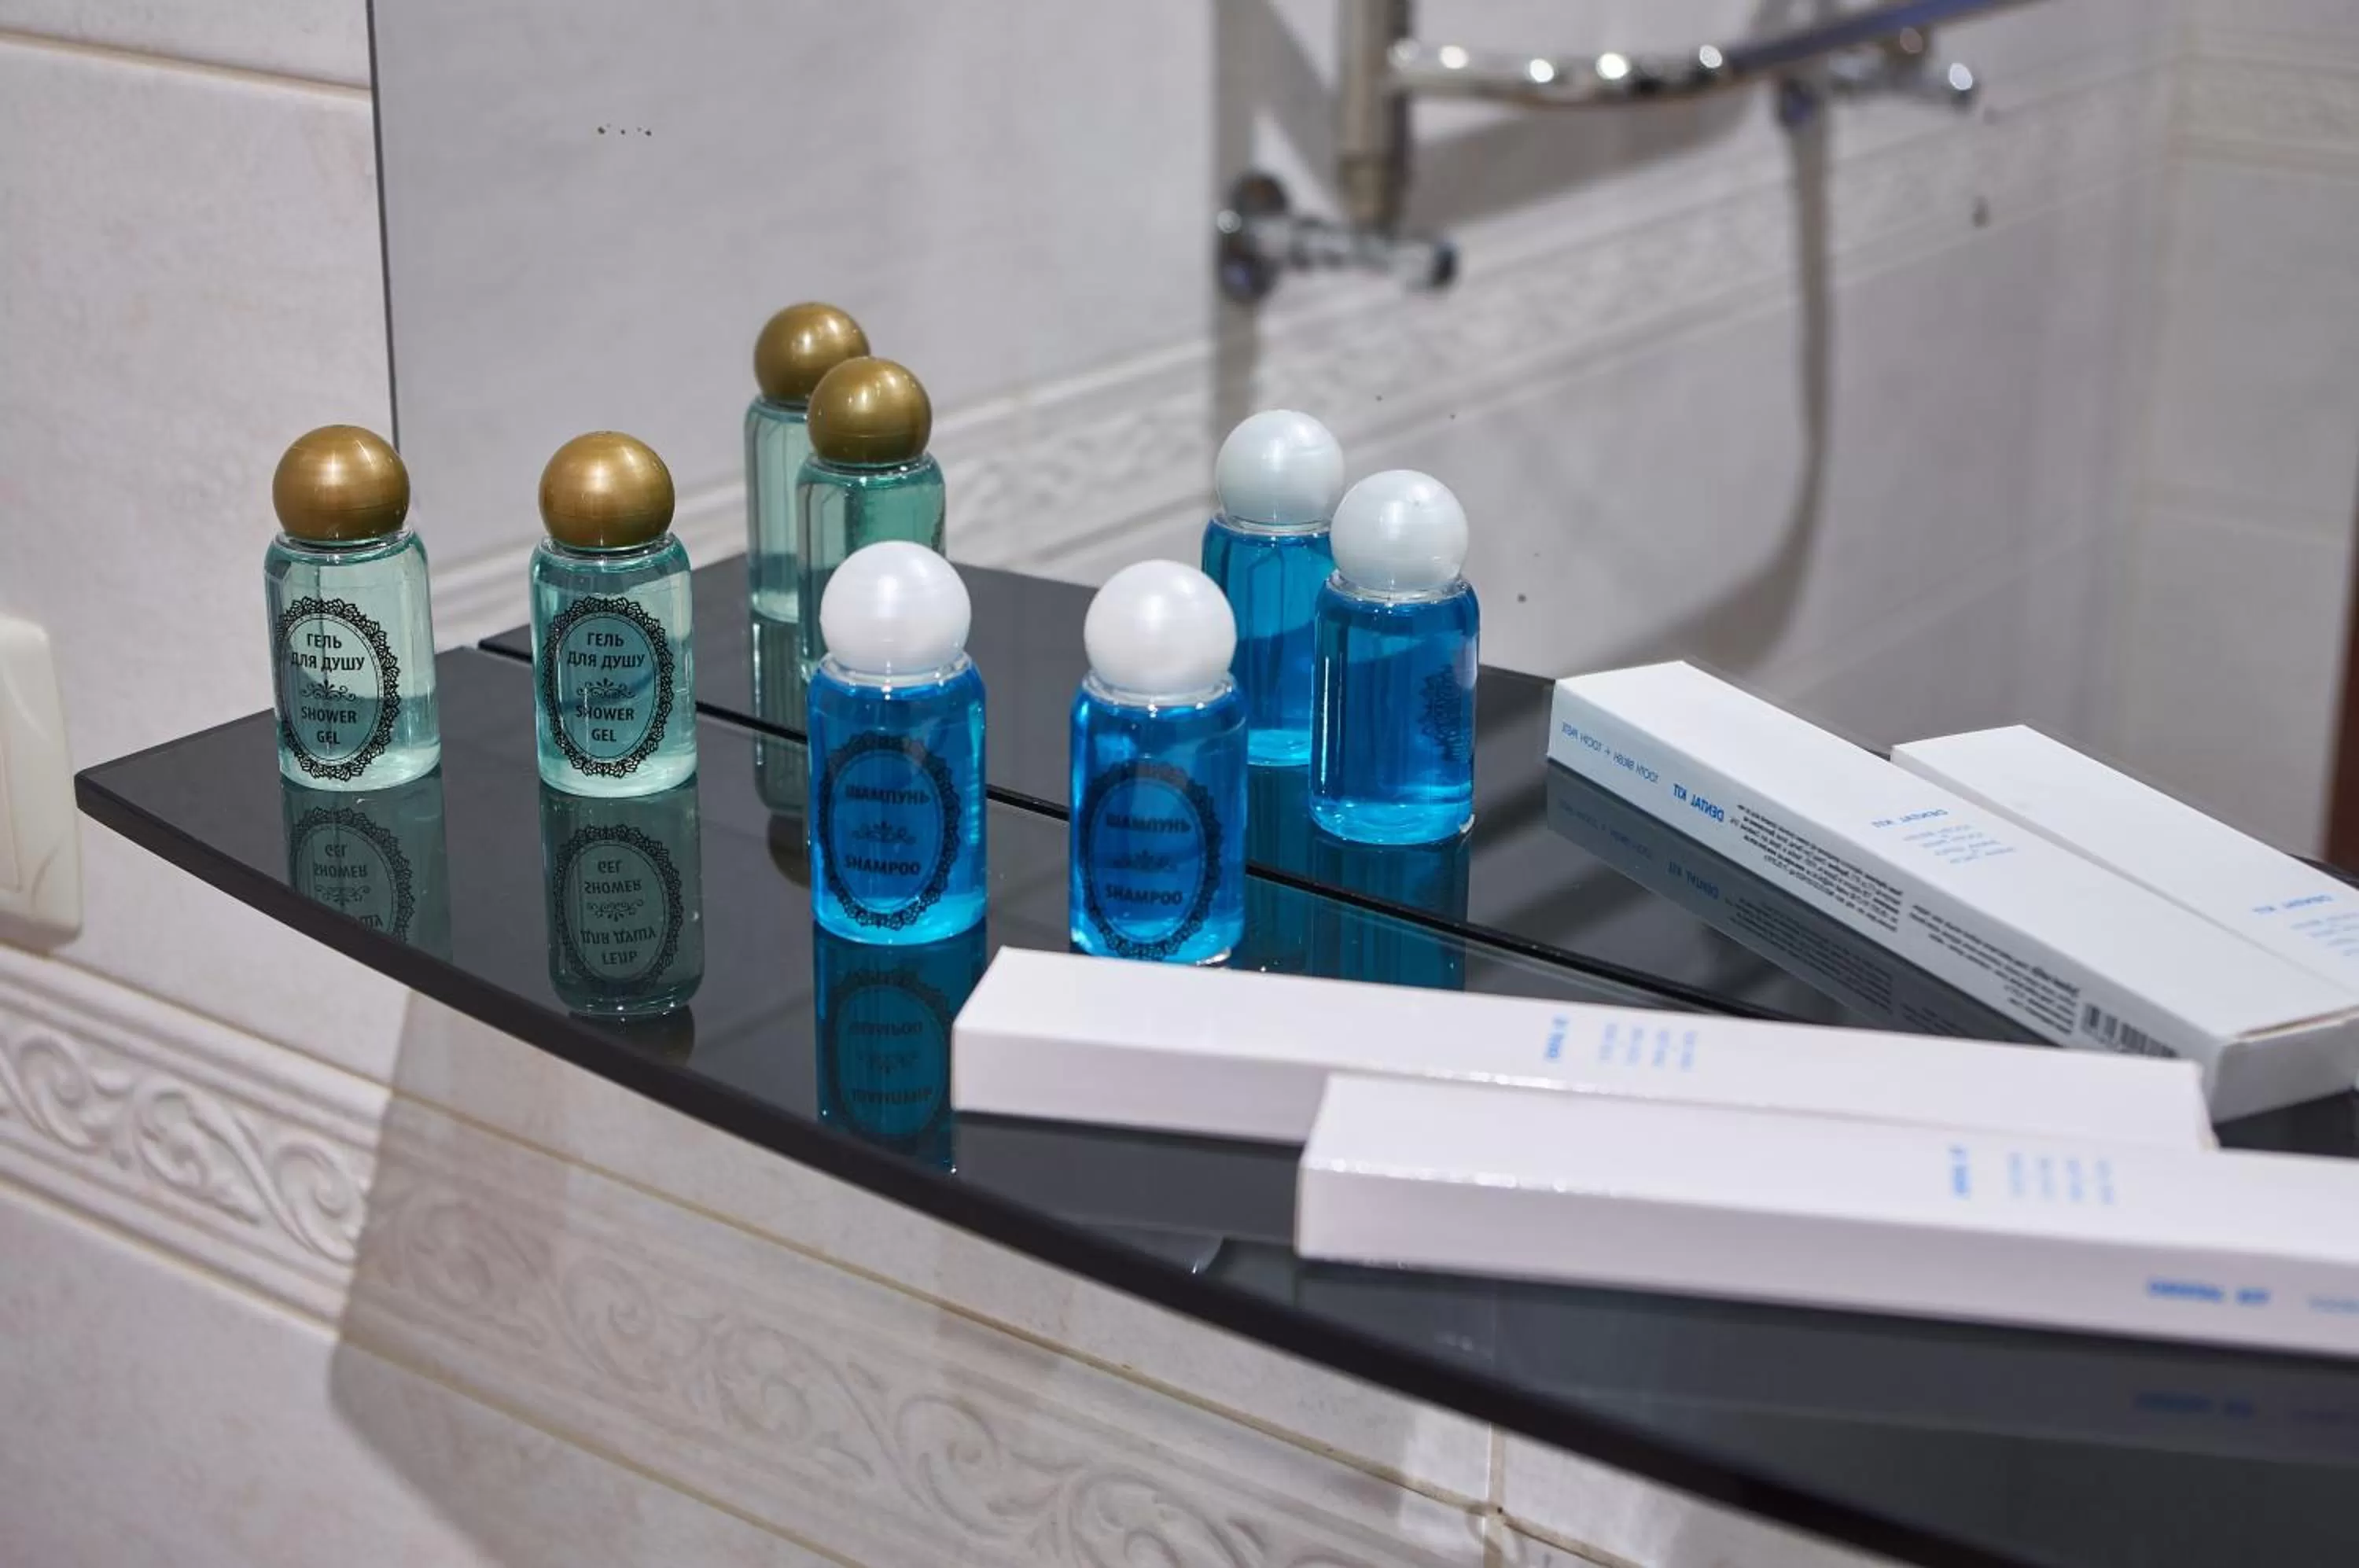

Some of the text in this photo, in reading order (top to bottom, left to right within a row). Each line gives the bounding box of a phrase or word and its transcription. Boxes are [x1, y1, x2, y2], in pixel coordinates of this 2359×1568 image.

[307, 633, 342, 649] ГЕЛЬ
[587, 632, 624, 647] ГЕЛЬ
[290, 652, 365, 672] ДЛЯ ДУШУ
[567, 651, 646, 671] ДЛЯ ДУШУ
[301, 706, 357, 723] SHOWER
[576, 705, 635, 721] SHOWER
[317, 731, 340, 744] GEL
[591, 728, 617, 742] GEL
[845, 785, 930, 805] ШАМПУНЬ
[1106, 814, 1191, 834] ШАМПУНЬ
[845, 855, 921, 875] SHAMPOO
[1105, 882, 1183, 906] SHAMPOO
